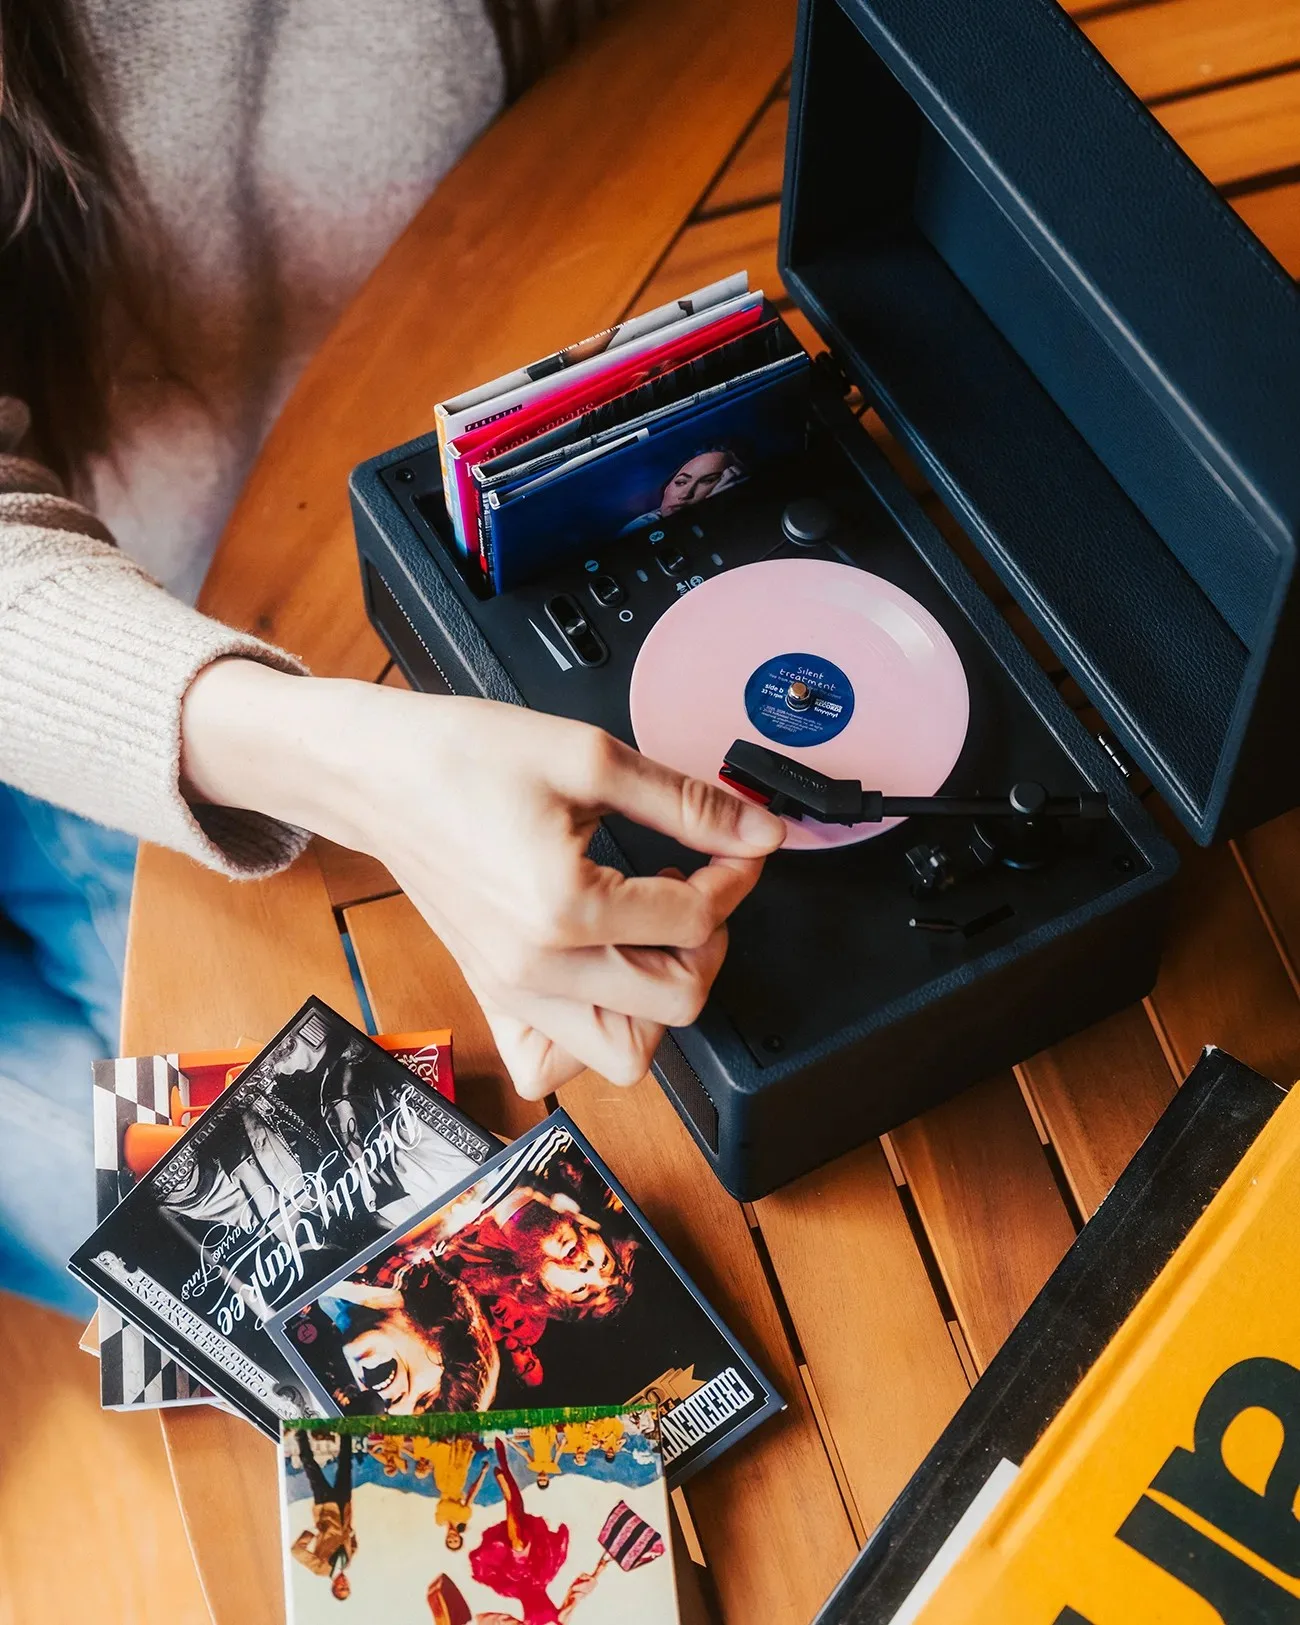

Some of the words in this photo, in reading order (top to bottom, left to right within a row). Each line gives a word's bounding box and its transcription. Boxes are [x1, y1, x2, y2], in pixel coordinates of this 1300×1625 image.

[764, 683, 779, 692] side
[779, 668, 837, 692] treatment
[797, 666, 824, 680] Silent
[292, 1085, 422, 1230] Daddy
[434, 1119, 483, 1163] CARTEL
[207, 1176, 325, 1336] Yankee
[125, 1278, 149, 1300] SAN
[185, 1327, 236, 1371] PUERTO
[235, 1366, 268, 1399] RICO
[139, 1276, 155, 1293] EL
[156, 1289, 207, 1335] CARTEL
[205, 1331, 267, 1383] RECORDS
